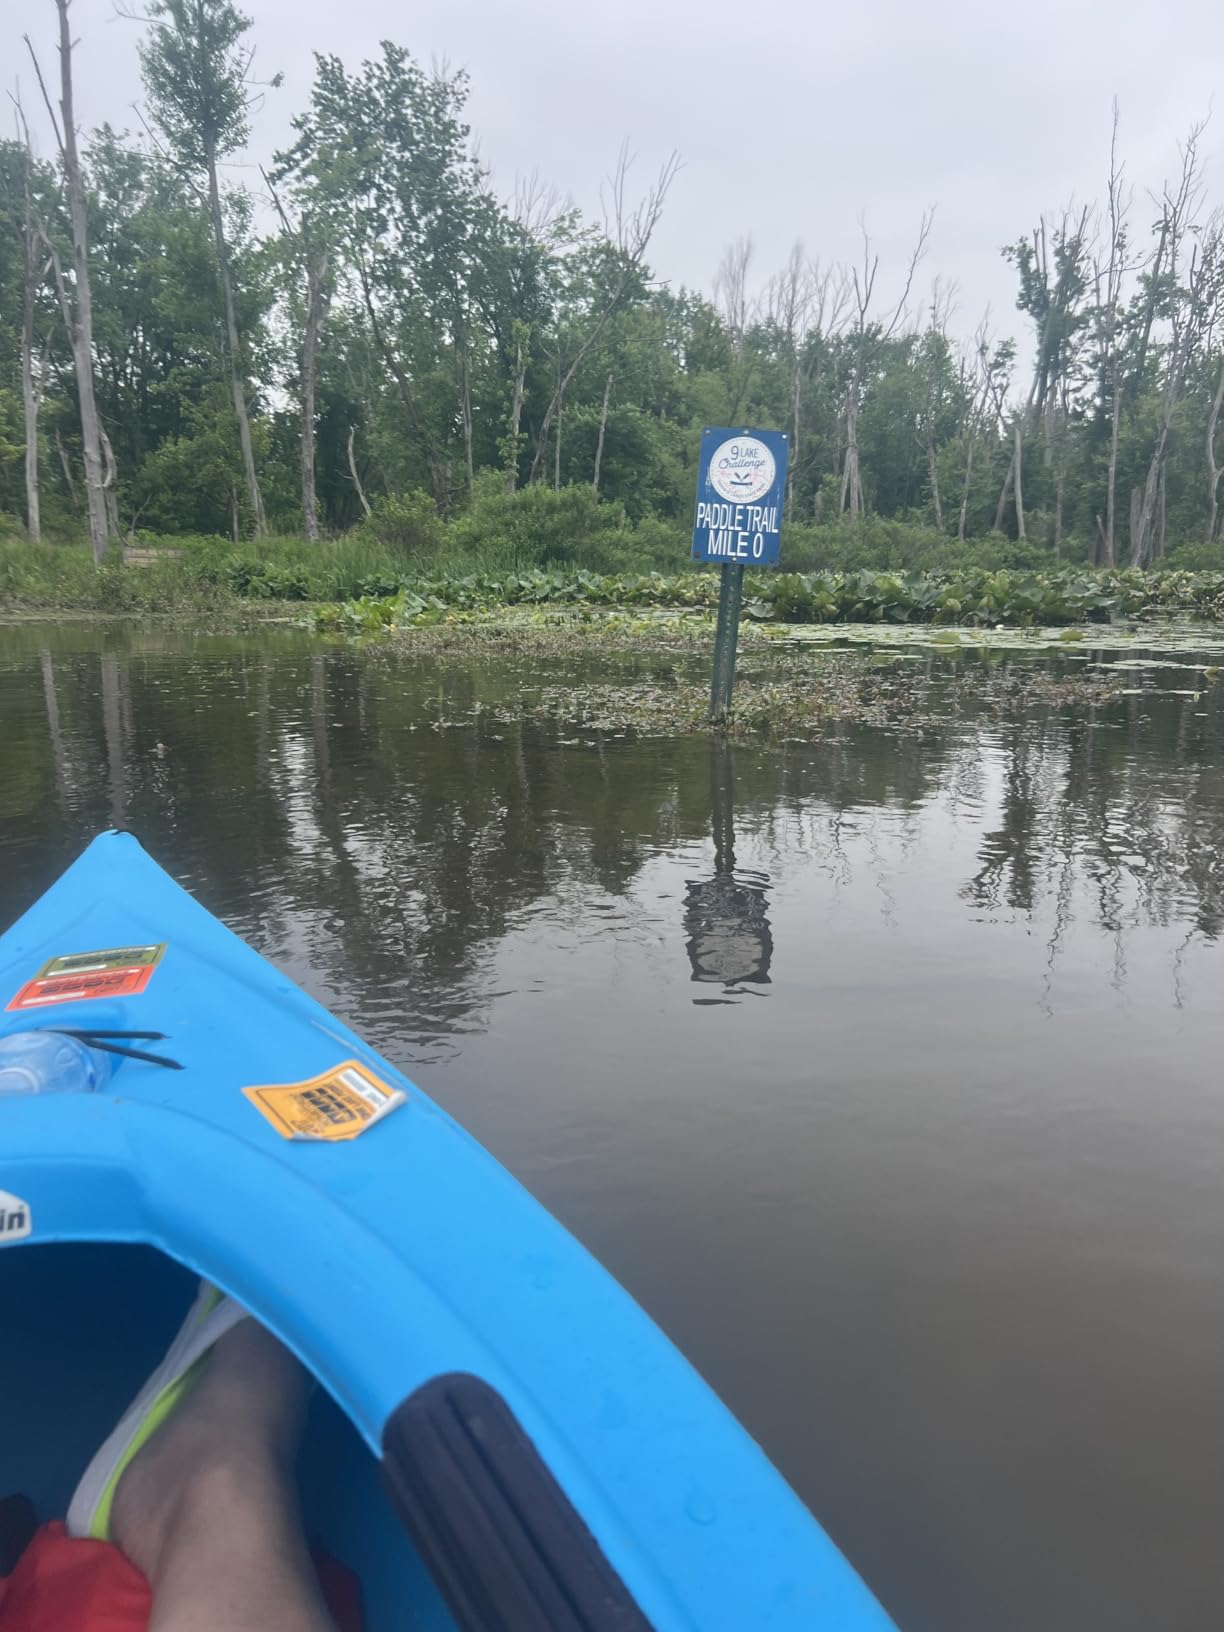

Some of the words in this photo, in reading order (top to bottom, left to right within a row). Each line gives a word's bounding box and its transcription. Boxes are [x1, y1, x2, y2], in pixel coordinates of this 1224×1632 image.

[718, 457, 766, 469] Challenge
[730, 445, 739, 461] 9
[740, 447, 759, 459] LAKE
[696, 502, 743, 531] PADDLE
[746, 506, 779, 533] TRAIL
[707, 529, 750, 557] MILE
[752, 532, 764, 558] 0
